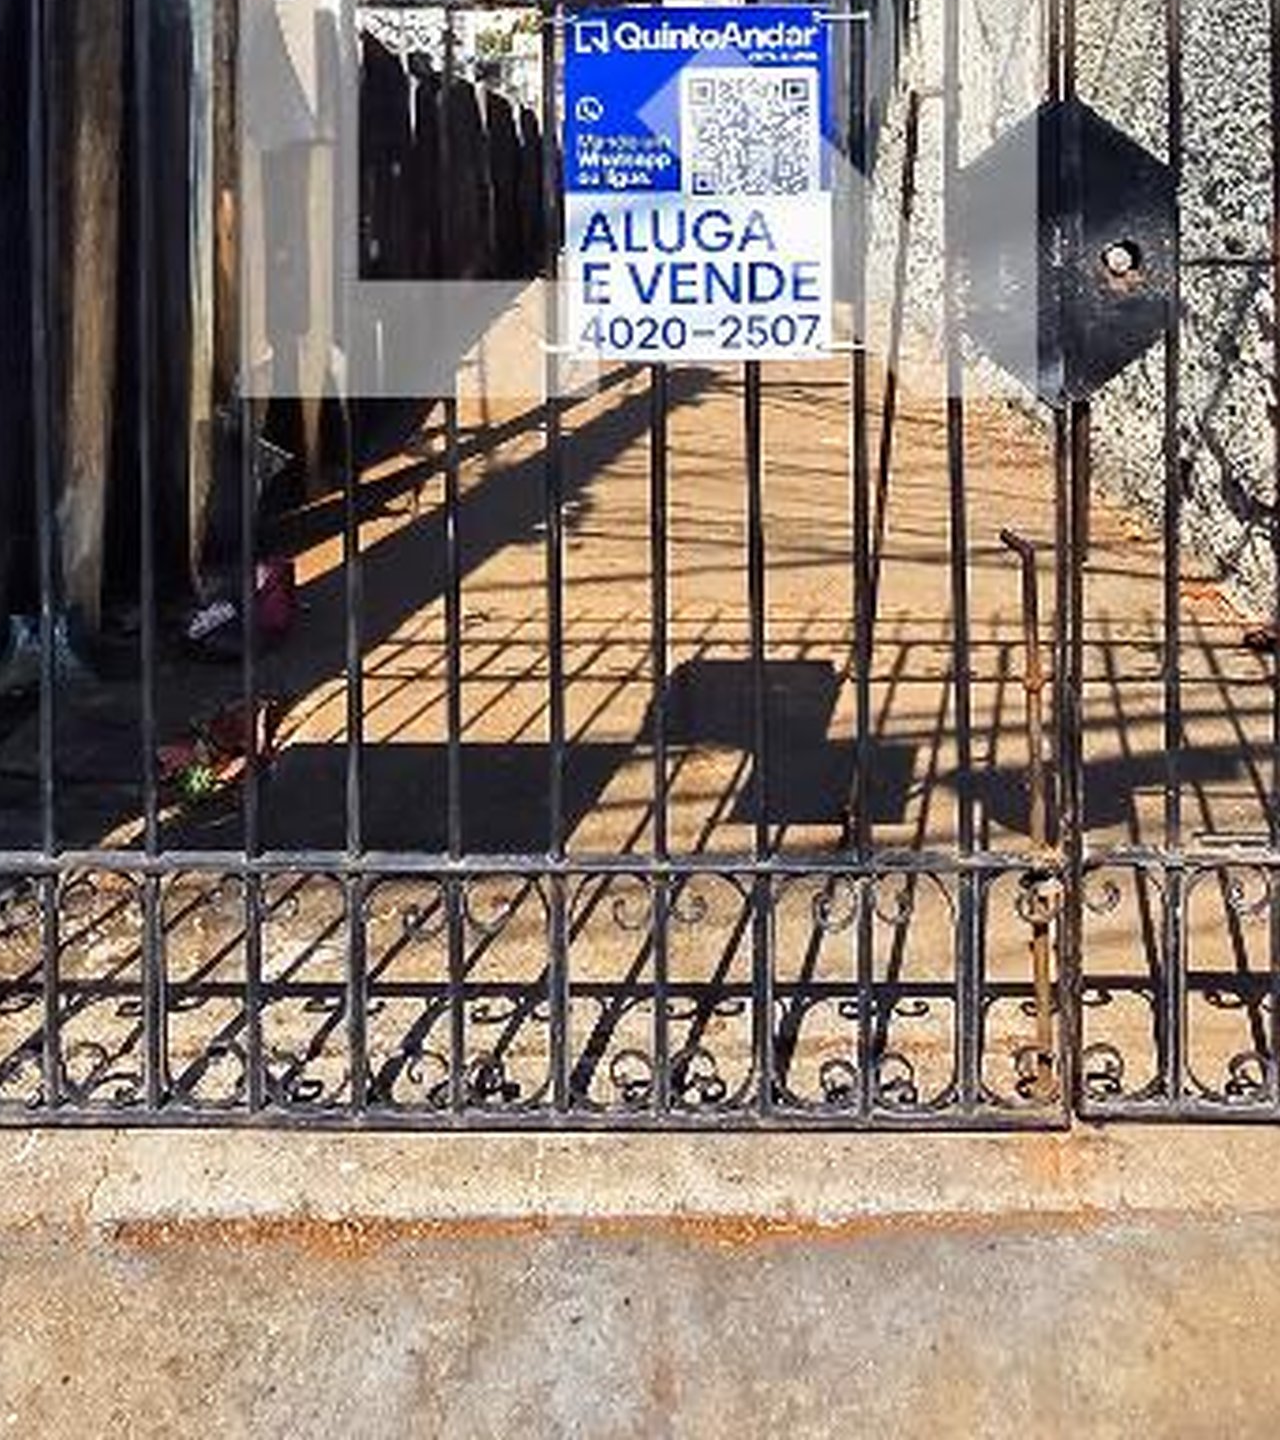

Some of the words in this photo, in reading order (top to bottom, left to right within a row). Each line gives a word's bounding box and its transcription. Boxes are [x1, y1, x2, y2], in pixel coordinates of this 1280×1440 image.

[614, 21, 818, 51] QuintoAndar
[578, 209, 776, 254] ALUGA
[582, 261, 612, 305] E
[627, 261, 822, 305] VENDE
[580, 313, 822, 351] 4020-2507
